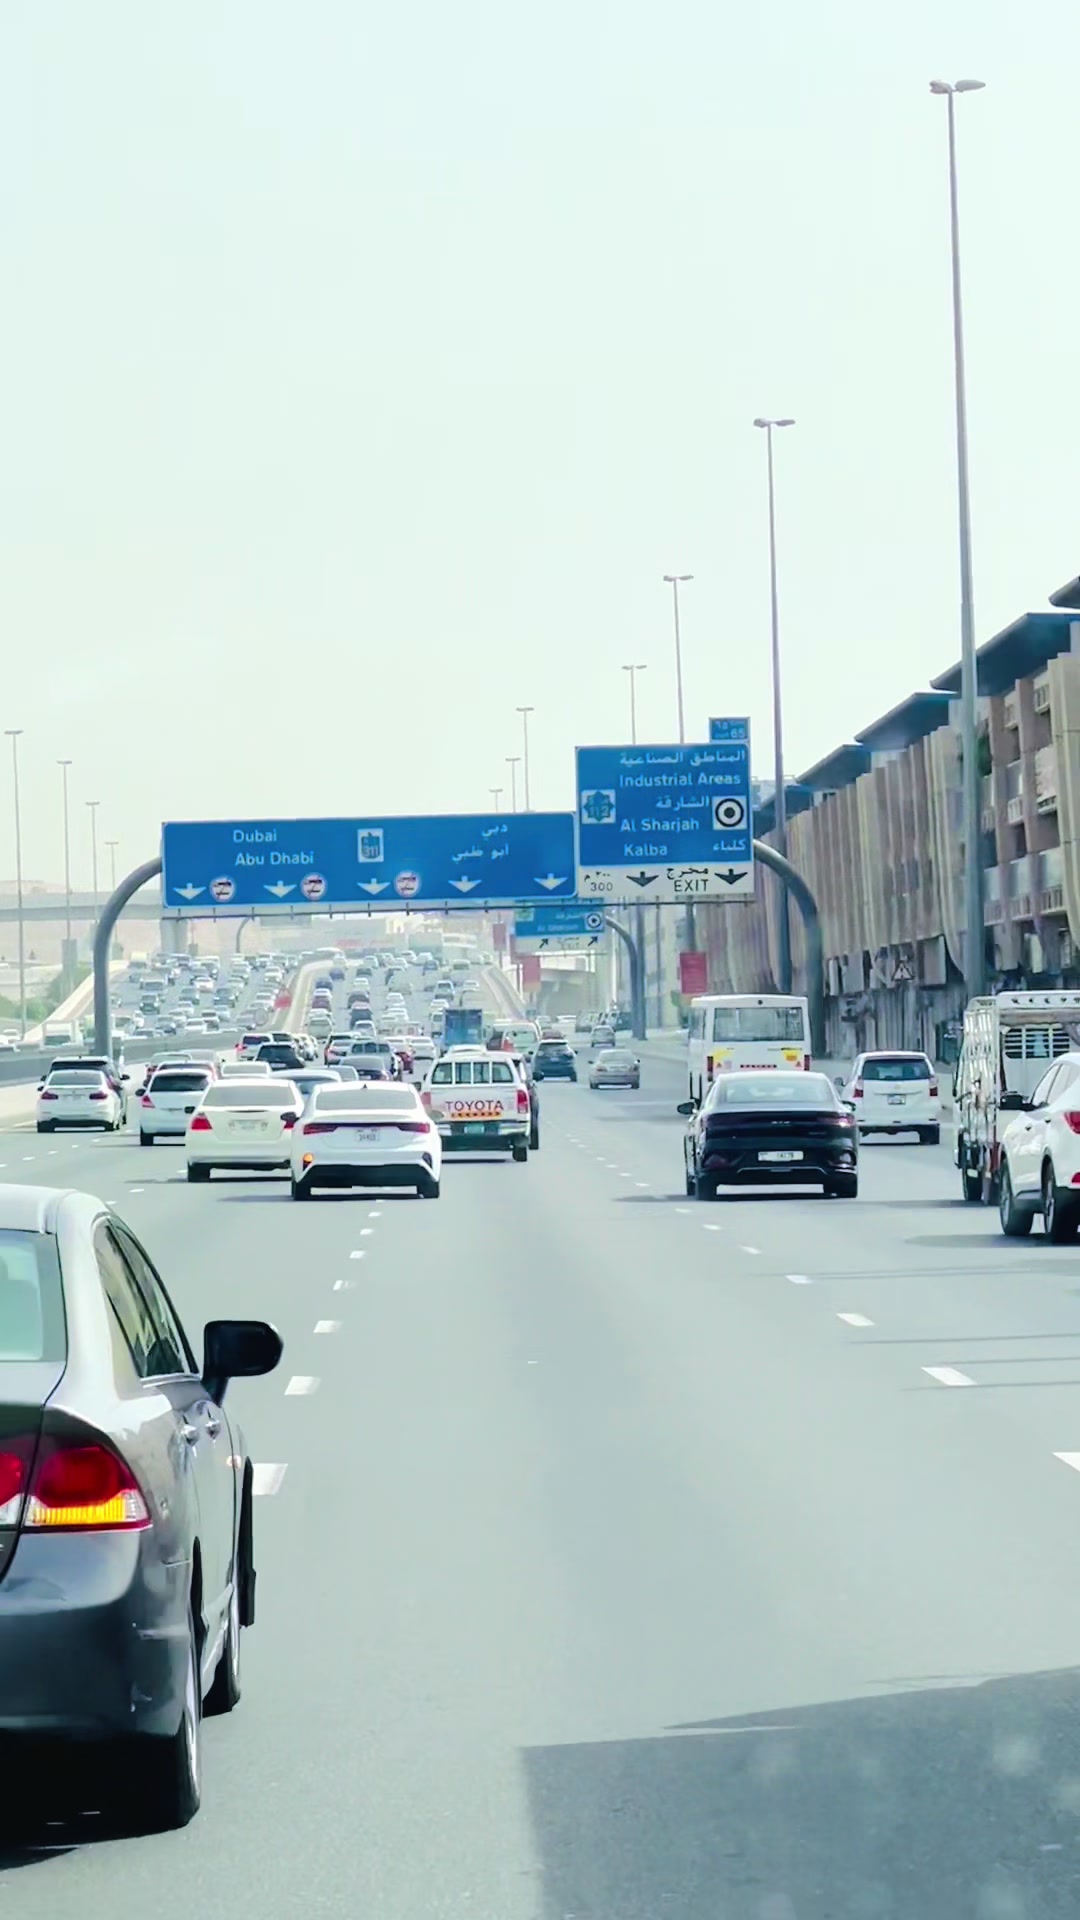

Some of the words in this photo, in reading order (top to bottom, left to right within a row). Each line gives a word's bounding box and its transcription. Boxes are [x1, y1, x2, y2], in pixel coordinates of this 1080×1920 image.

[619, 752, 684, 768] الصناعية
[690, 750, 745, 767] المناطق
[620, 774, 693, 787] Industrial
[698, 772, 741, 785] Areas
[655, 796, 709, 811] الشارقة
[621, 819, 636, 832] Al
[641, 817, 699, 833] Sharjah
[233, 829, 277, 843] Dubai
[481, 824, 508, 841] دبي
[624, 843, 668, 857] Kalba
[713, 839, 747, 851] كلباء
[235, 851, 265, 866] Abu
[270, 850, 314, 865] Dhabi
[667, 866, 709, 880] مخرج
[590, 882, 613, 892] 300
[674, 878, 710, 892] EXIT
[445, 1100, 504, 1111] TOYOTA
